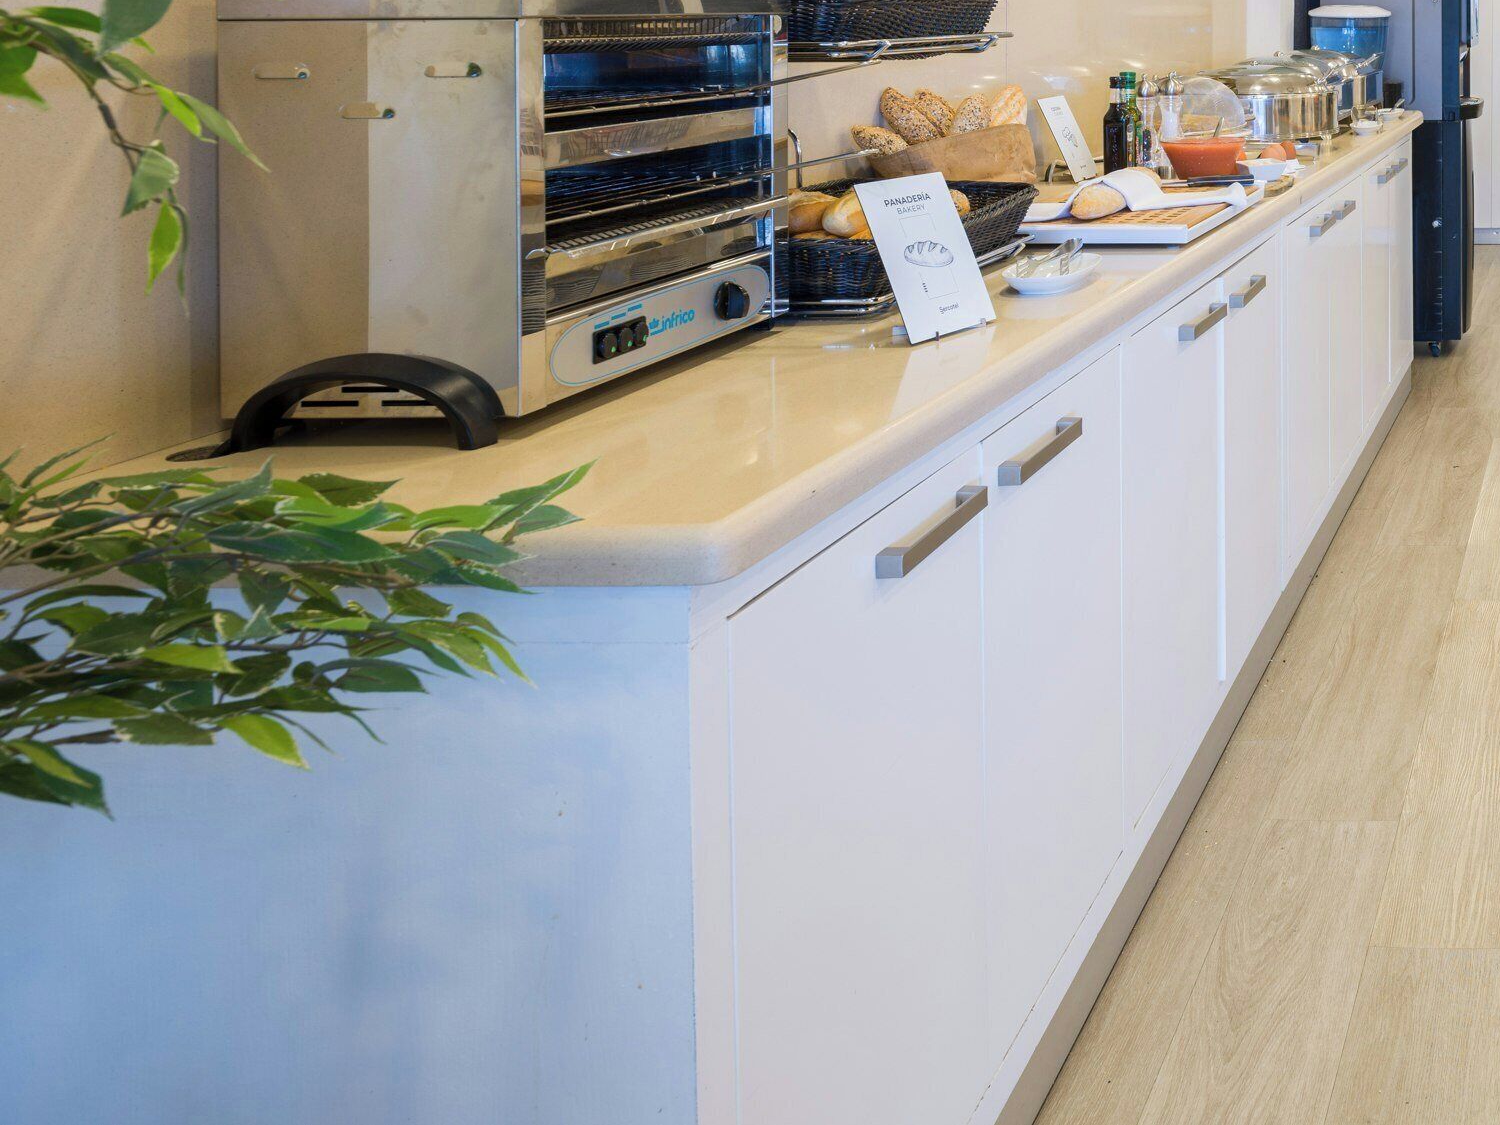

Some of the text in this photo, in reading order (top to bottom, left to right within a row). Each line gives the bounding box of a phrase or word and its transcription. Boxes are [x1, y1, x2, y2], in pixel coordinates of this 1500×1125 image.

[884, 191, 931, 208] PANADERÍA
[896, 203, 926, 215] BAKERY
[661, 309, 696, 334] infrico
